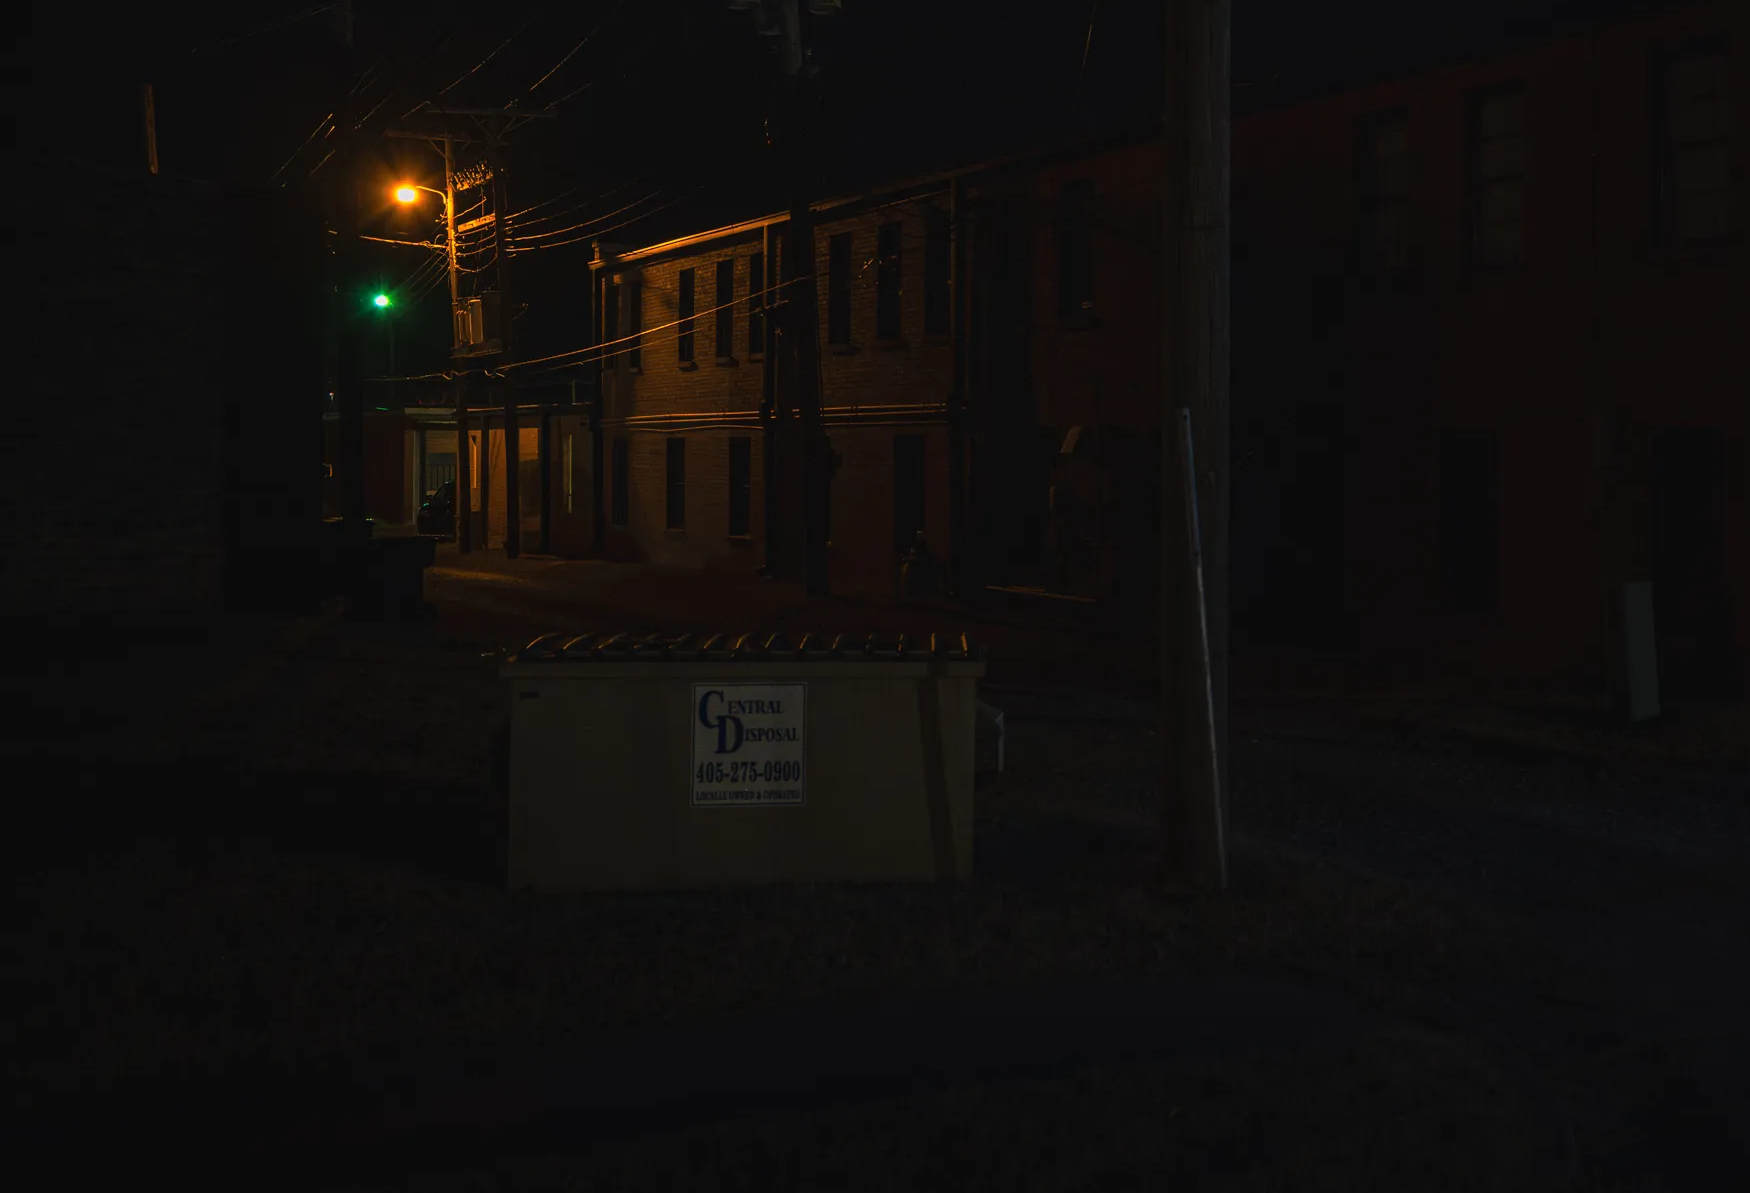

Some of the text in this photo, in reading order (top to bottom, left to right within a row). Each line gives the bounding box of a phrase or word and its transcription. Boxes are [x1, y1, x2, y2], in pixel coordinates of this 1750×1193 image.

[699, 690, 784, 729] CENTRAL
[715, 715, 800, 754] DISPOSAL
[696, 760, 800, 783] 405-275-0900
